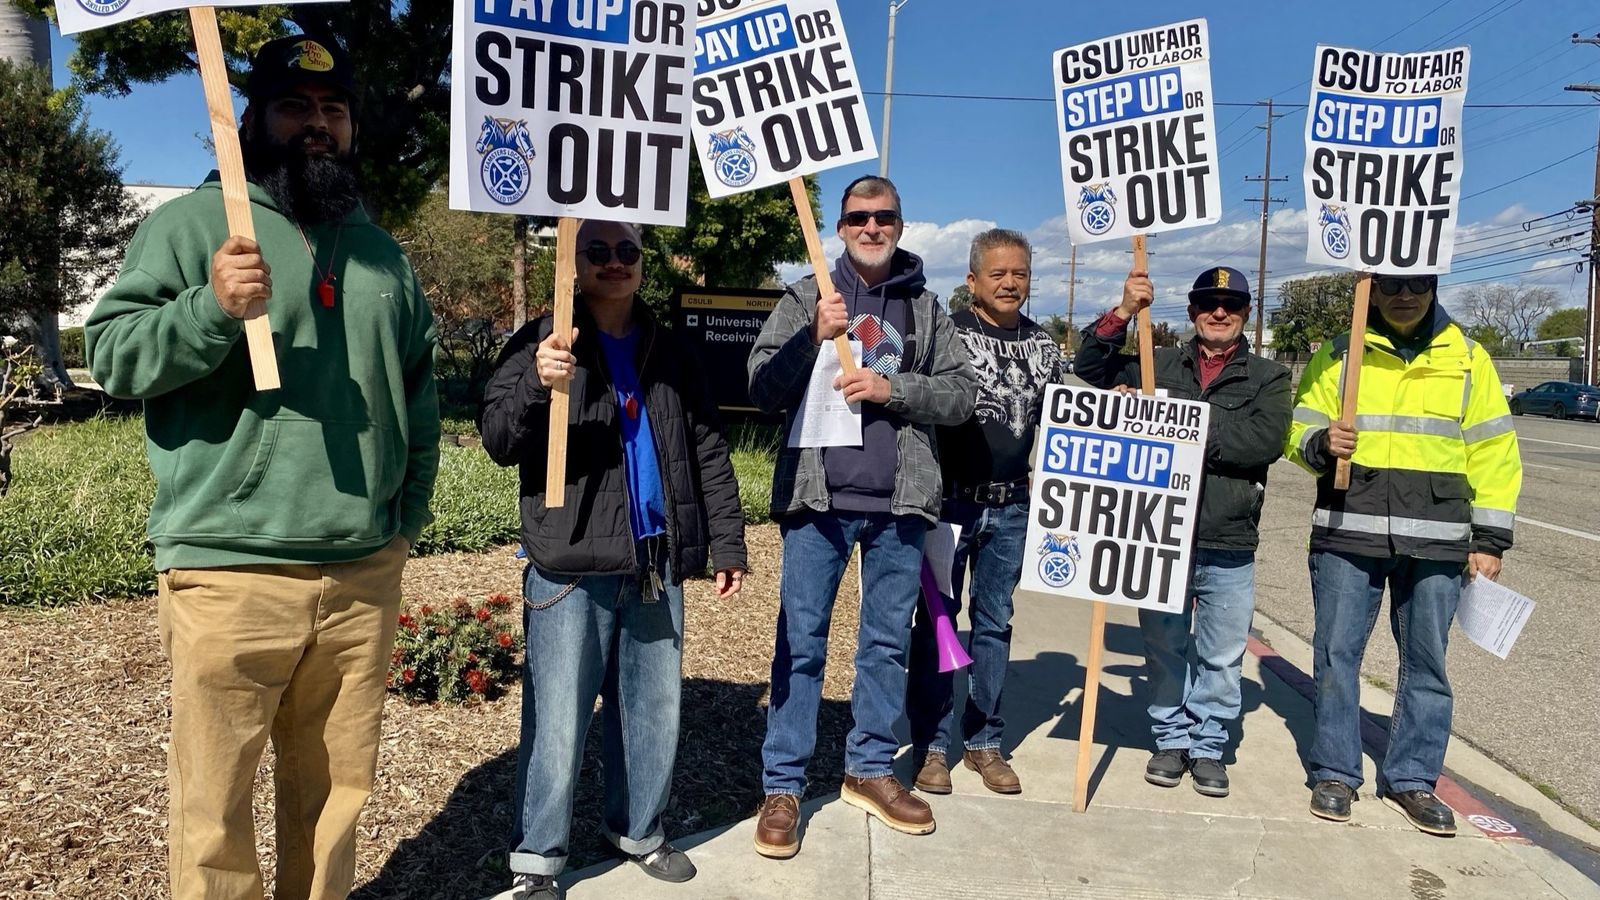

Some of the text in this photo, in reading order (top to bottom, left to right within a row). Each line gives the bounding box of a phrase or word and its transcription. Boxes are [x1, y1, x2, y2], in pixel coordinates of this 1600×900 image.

[634, 0, 685, 46] OR
[744, 12, 787, 51] UP
[795, 9, 836, 44] OR
[475, 30, 685, 124] STRIKE
[1061, 23, 1201, 84] CSU UNFAIR
[1128, 47, 1203, 70] TO LABOR
[1318, 48, 1464, 93] CSU UNFAIR
[692, 42, 852, 126] STRIKE
[1066, 73, 1204, 127] STEP UP OR
[1385, 76, 1462, 94] TO LABOR
[761, 95, 864, 172] OUT
[1315, 99, 1455, 146] STEP UP OR
[484, 148, 507, 172] TEAMSTERS
[507, 149, 522, 163] LOCAL
[547, 122, 683, 211] OUT
[1068, 113, 1207, 183] STRIKE
[488, 186, 507, 202] SKILLED
[1126, 165, 1210, 229] OUT
[1312, 147, 1454, 207] STRIKE
[1359, 208, 1450, 268] OUT
[687, 297, 713, 305] CSULB
[706, 315, 767, 330] University
[705, 330, 758, 342] Receivin
[1050, 388, 1202, 430] CSU UNFAIR
[1123, 420, 1200, 442] TO LABOR
[1047, 433, 1191, 491] STEP UP OR
[1038, 478, 1187, 547] STRIKE
[1089, 539, 1180, 604] OUT
